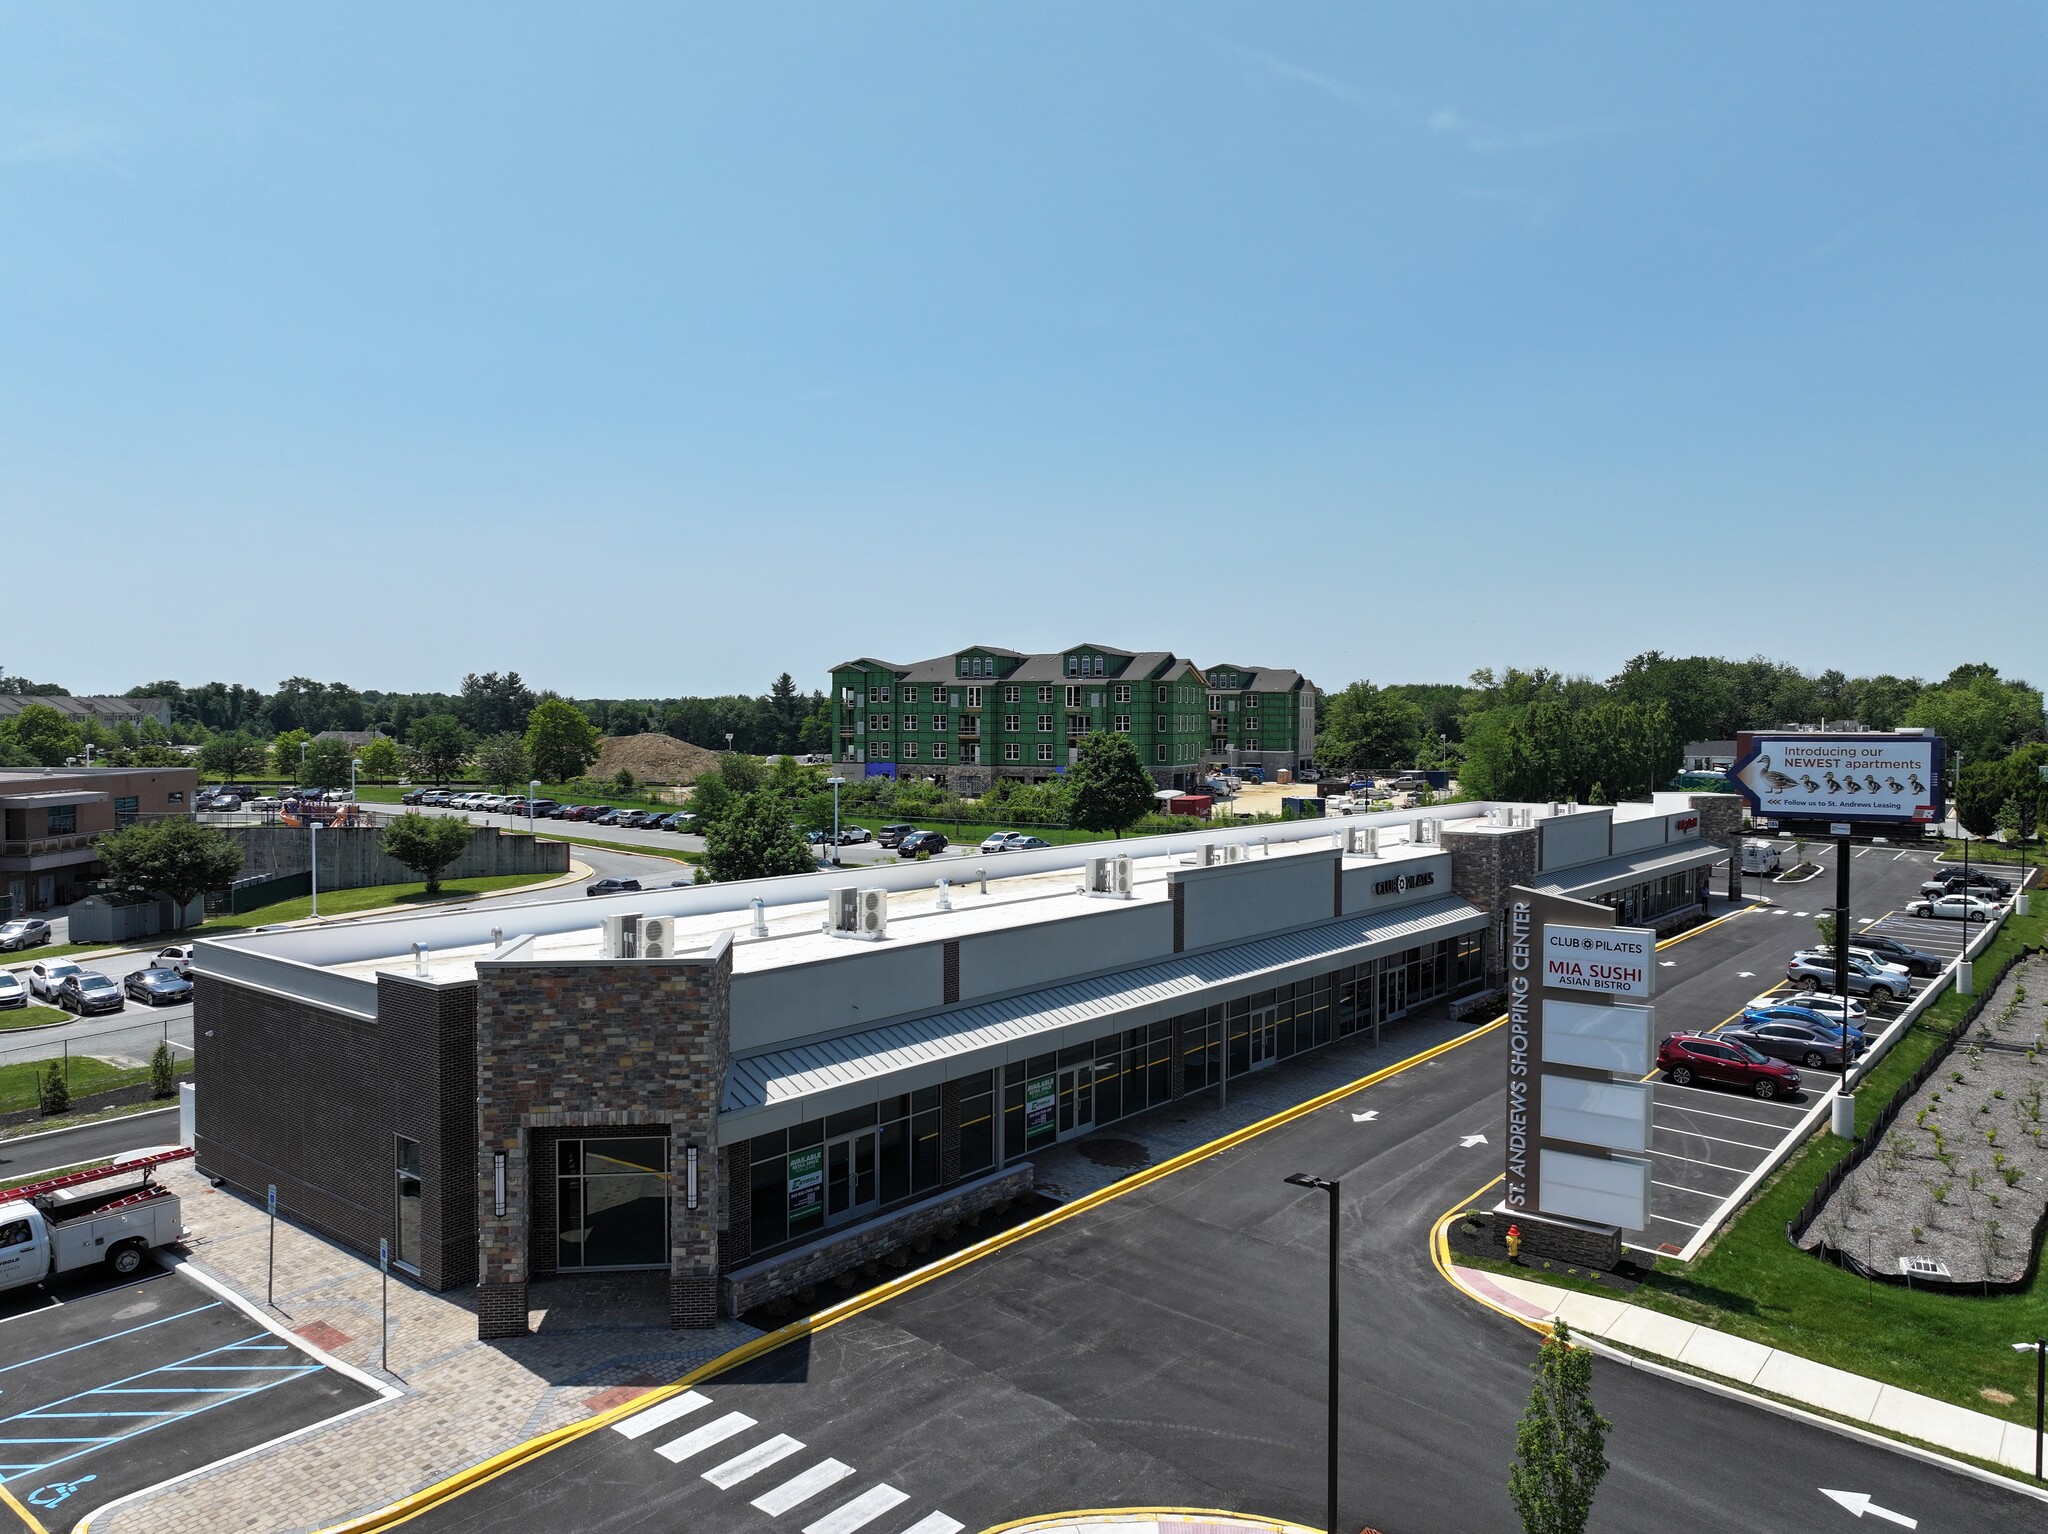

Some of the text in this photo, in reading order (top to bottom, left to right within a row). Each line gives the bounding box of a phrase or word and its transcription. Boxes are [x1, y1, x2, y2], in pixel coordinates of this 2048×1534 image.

[1784, 746, 1883, 758] Introducing our
[1784, 758, 1921, 770] NEWEST apartments
[1784, 799, 1806, 807] Follow
[1374, 879, 1398, 895] CLUB
[1550, 936, 1643, 954] CLUB PILATES
[1549, 960, 1642, 982] MIA SUSHI
[1559, 976, 1631, 991] ASIAN BISTRO
[1508, 902, 1531, 1206] ST. ANDREWS SHOPPING CENTER
[790, 1152, 821, 1167] AVAILABLE
